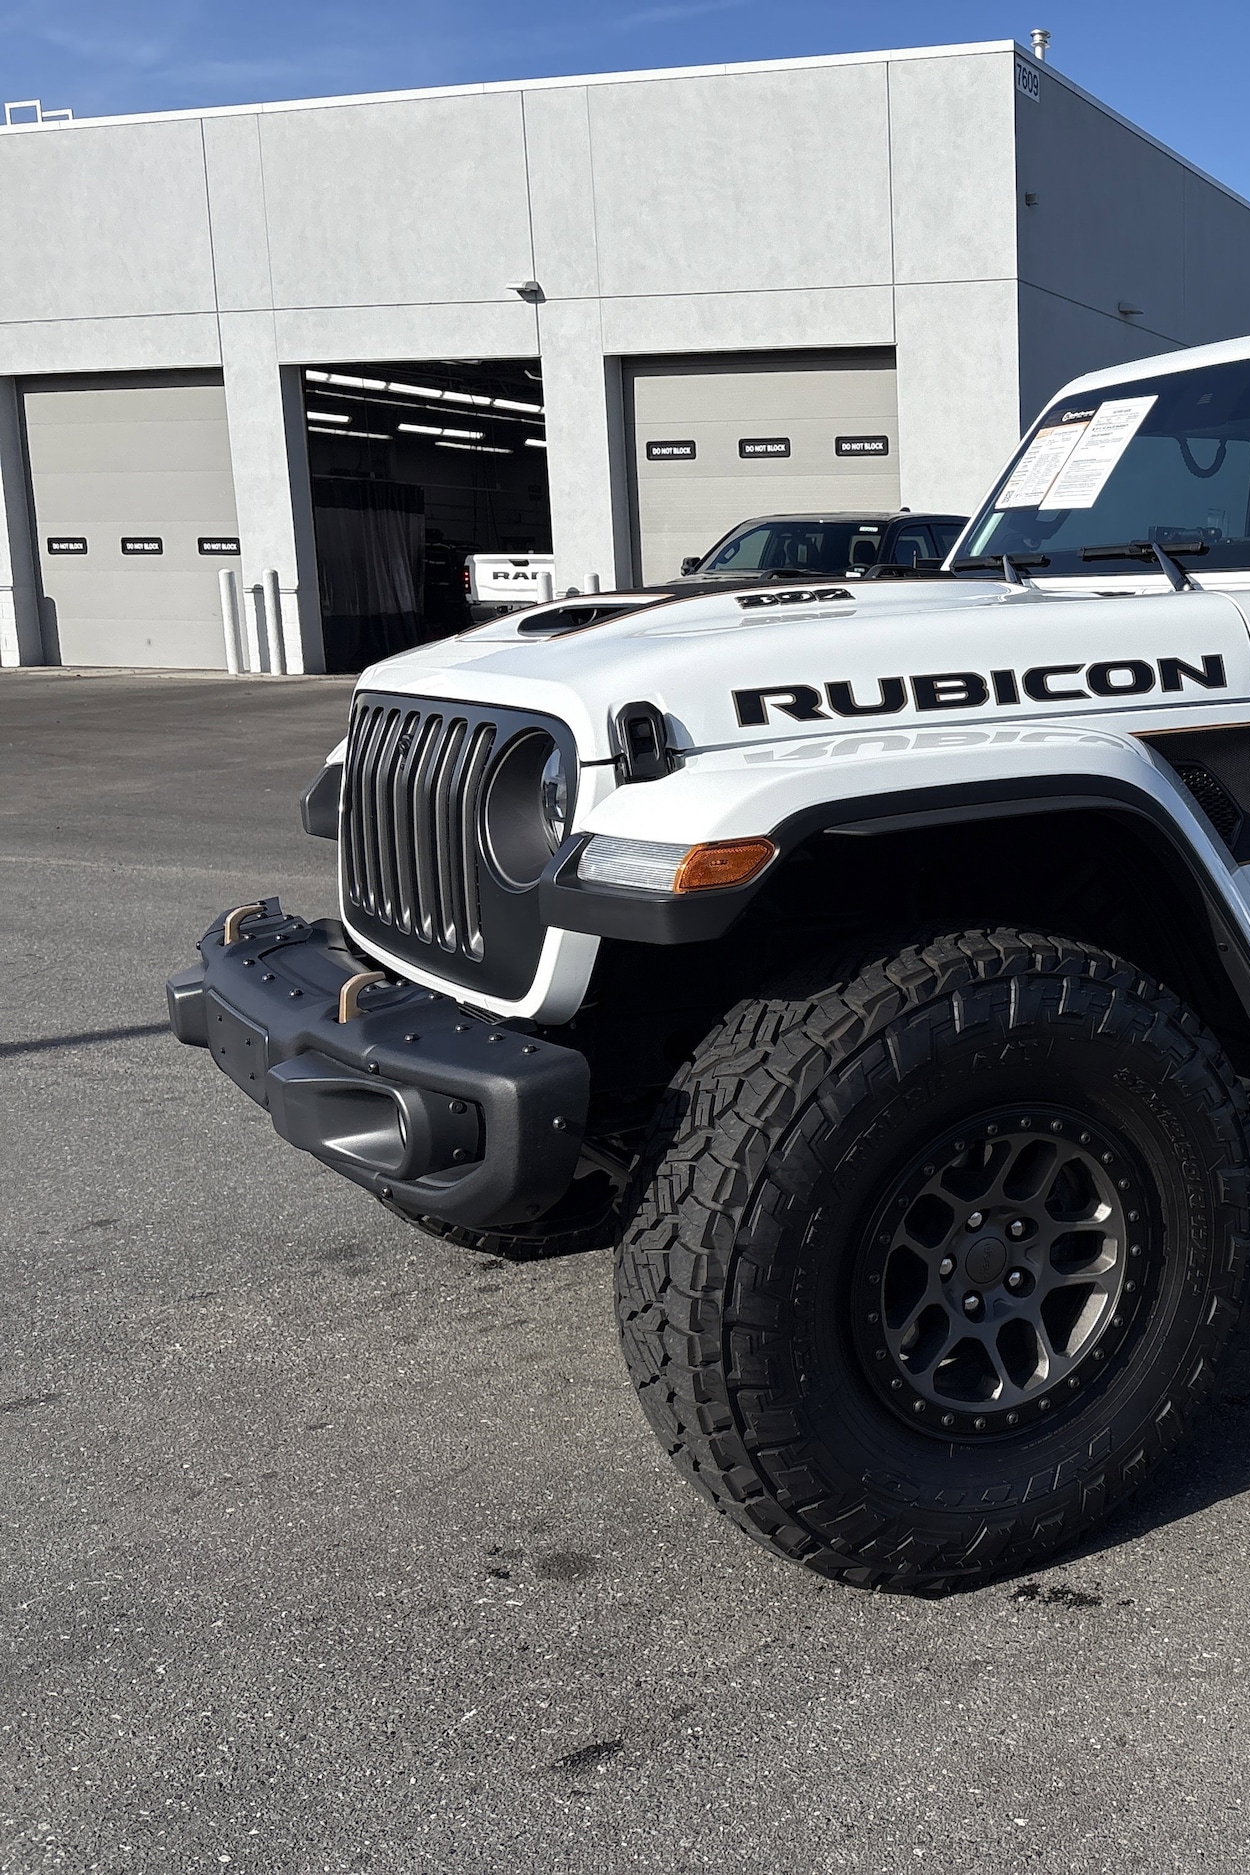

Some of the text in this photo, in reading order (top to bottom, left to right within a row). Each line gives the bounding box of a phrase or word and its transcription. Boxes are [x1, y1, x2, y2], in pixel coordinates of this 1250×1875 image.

[1016, 63, 1039, 96] 7609
[652, 446, 691, 455] DO NOT BLOCK
[745, 444, 786, 453] DO NOT BLOCK
[841, 442, 884, 450] DO NOT BLOCK
[52, 542, 84, 550] DO NOT BLOCK
[126, 542, 159, 550] DO NOT BLOCK
[734, 588, 857, 609] 392
[731, 653, 1228, 728] RUBICON
